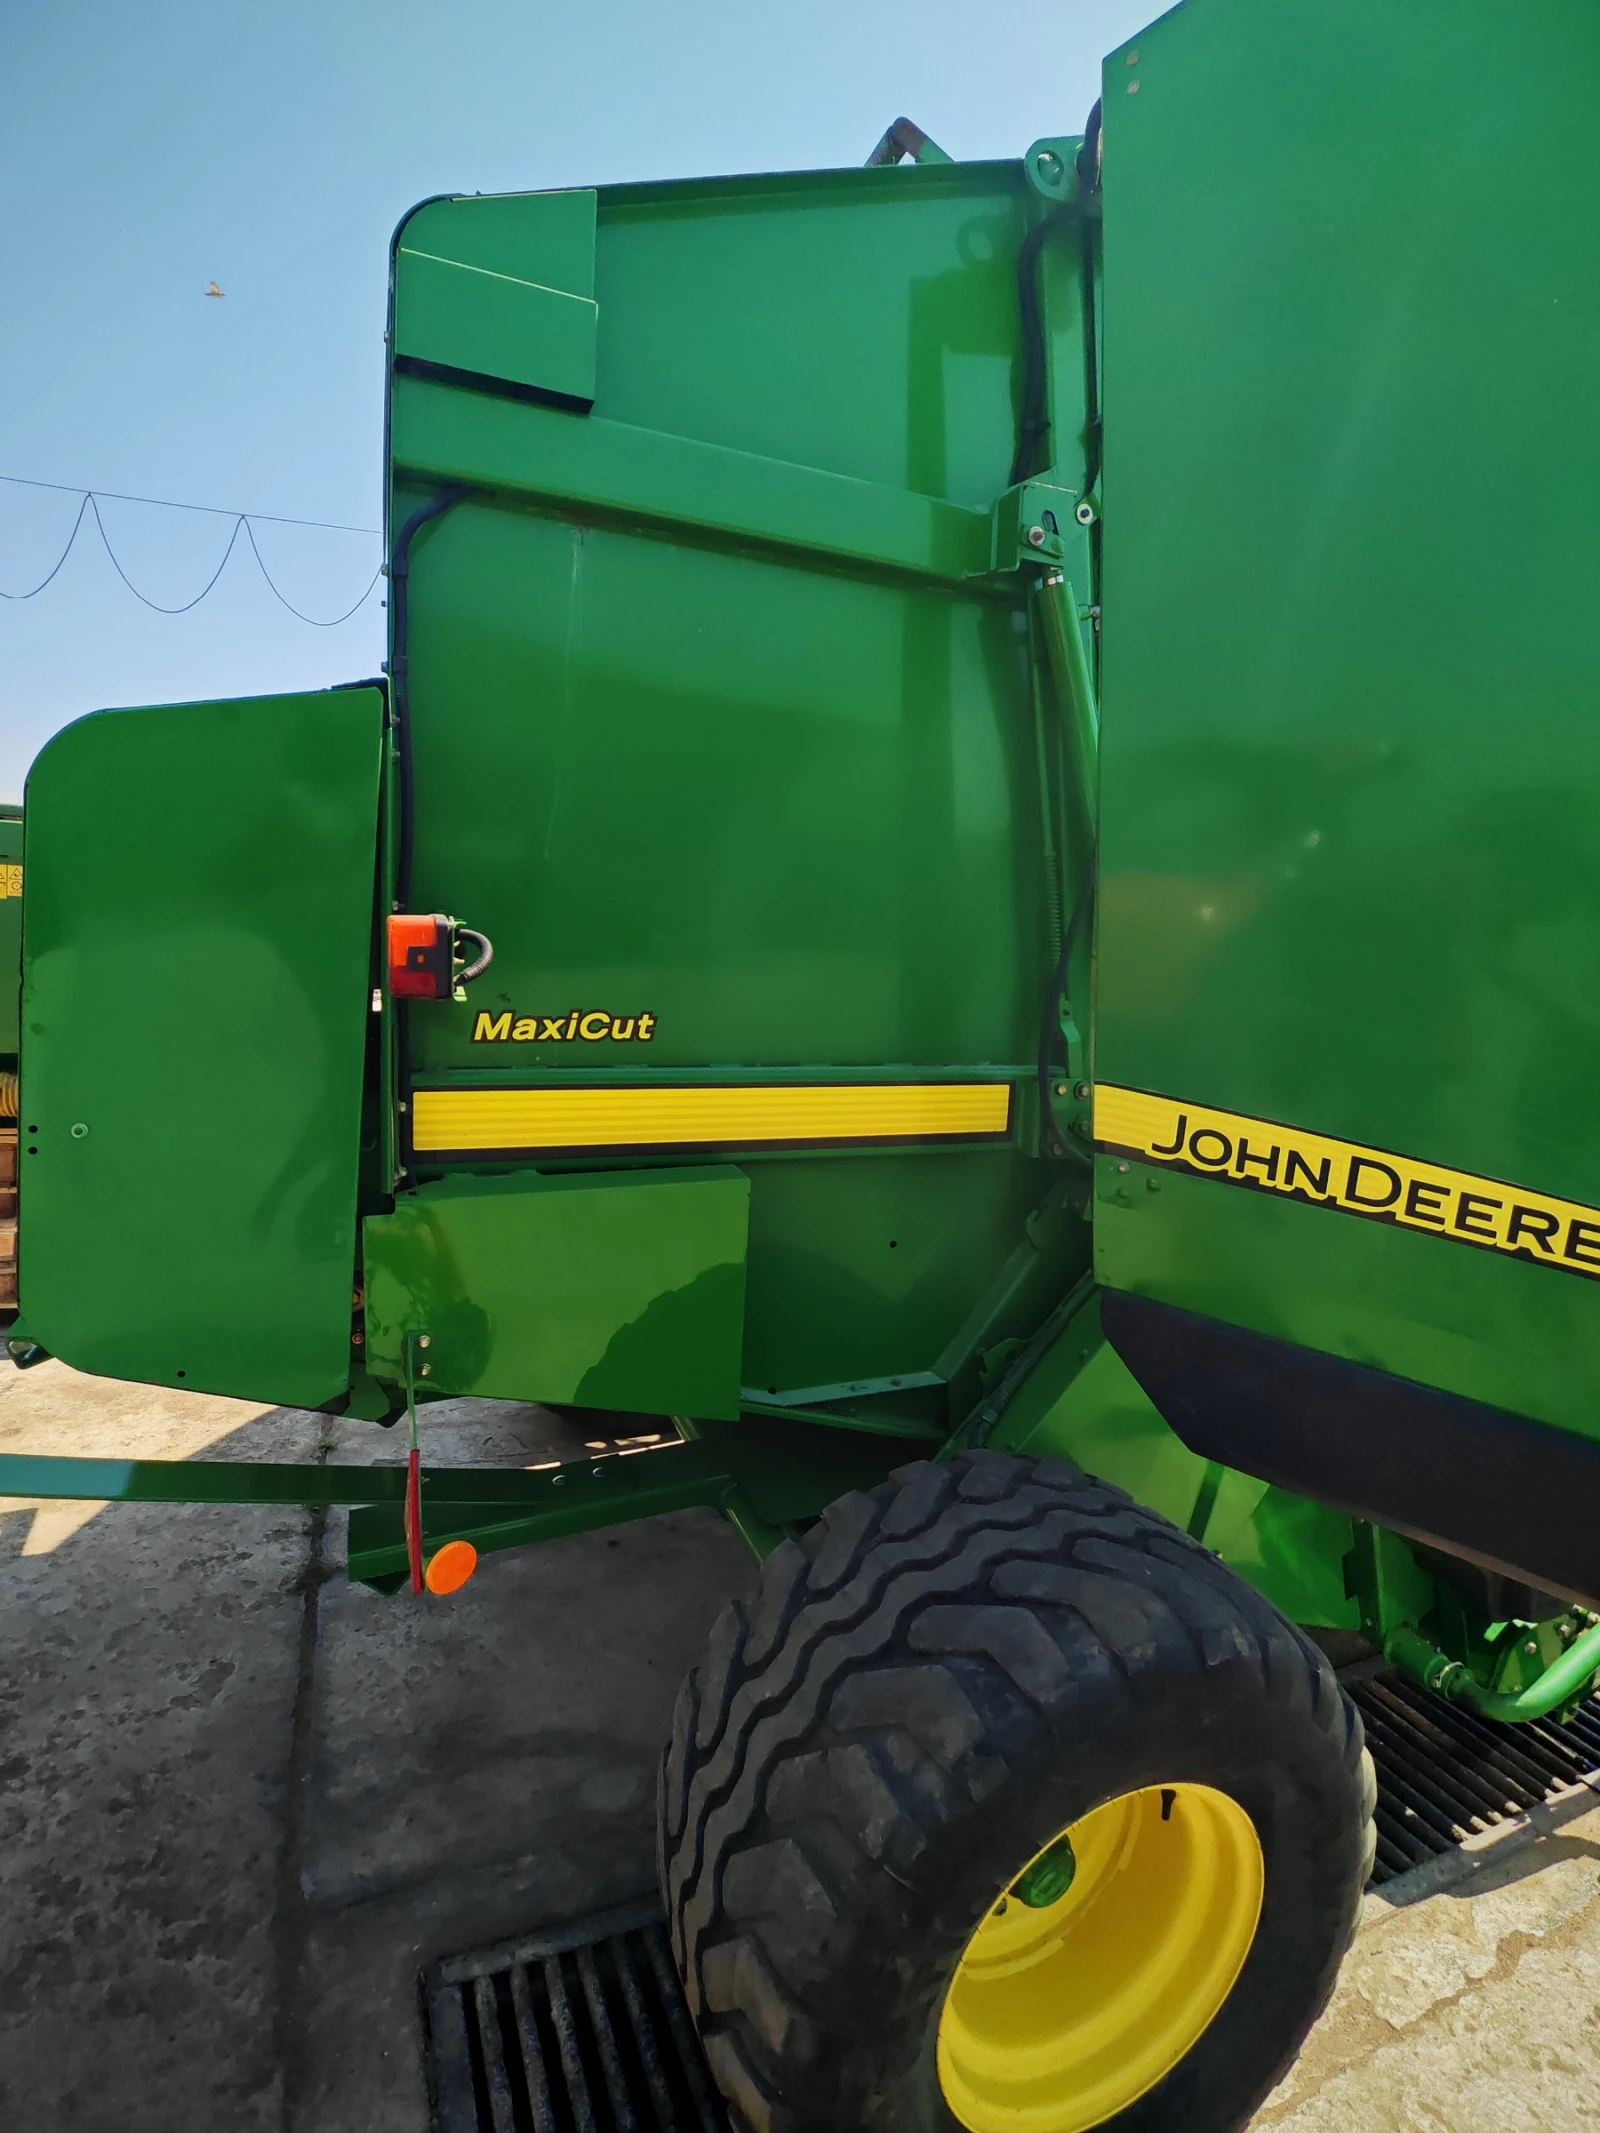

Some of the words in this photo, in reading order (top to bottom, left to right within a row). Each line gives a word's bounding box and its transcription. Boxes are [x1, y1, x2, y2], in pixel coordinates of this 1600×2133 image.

[473, 1011, 655, 1042] MaxiCut
[1151, 1114, 1332, 1196] JOHN
[1344, 1155, 1600, 1266] DEERE
